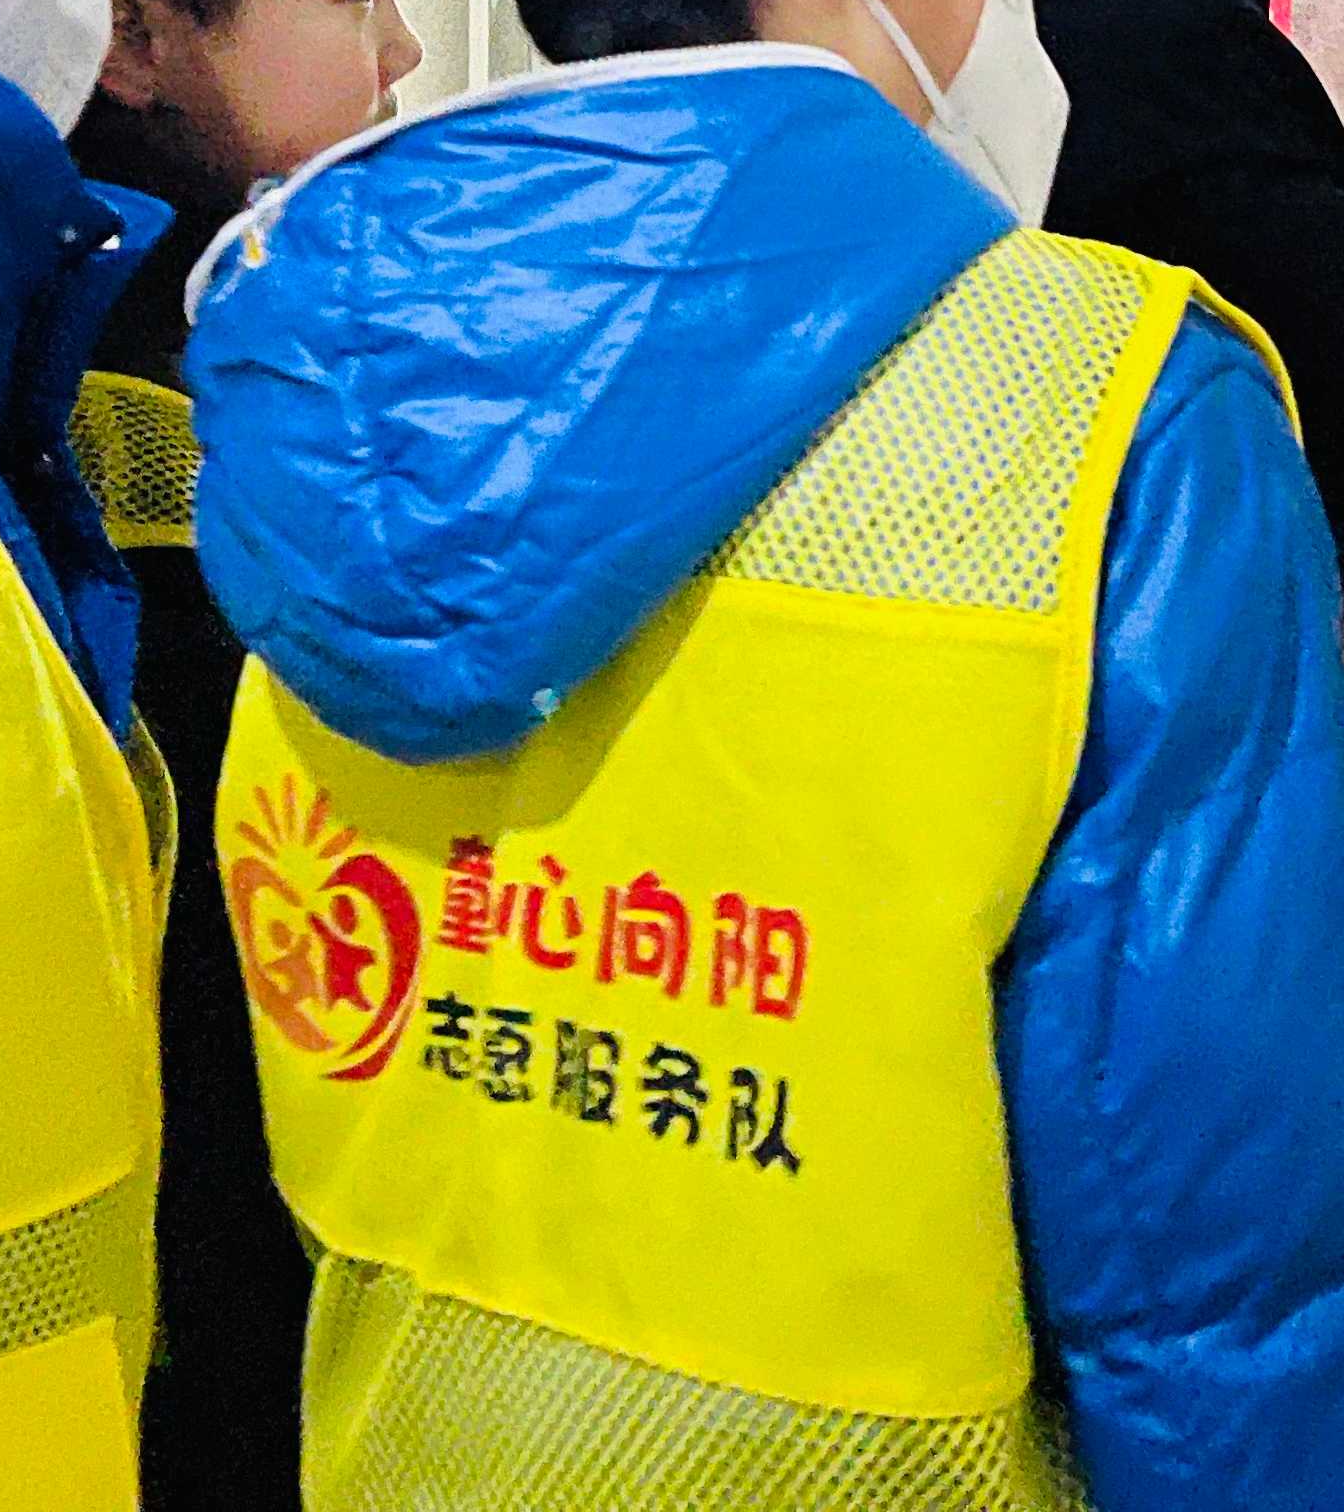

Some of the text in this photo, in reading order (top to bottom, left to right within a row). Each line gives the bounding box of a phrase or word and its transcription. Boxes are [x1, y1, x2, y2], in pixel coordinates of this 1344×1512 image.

[434, 834, 810, 1021] 童心向阳
[422, 992, 802, 1176] 志愿服务队
